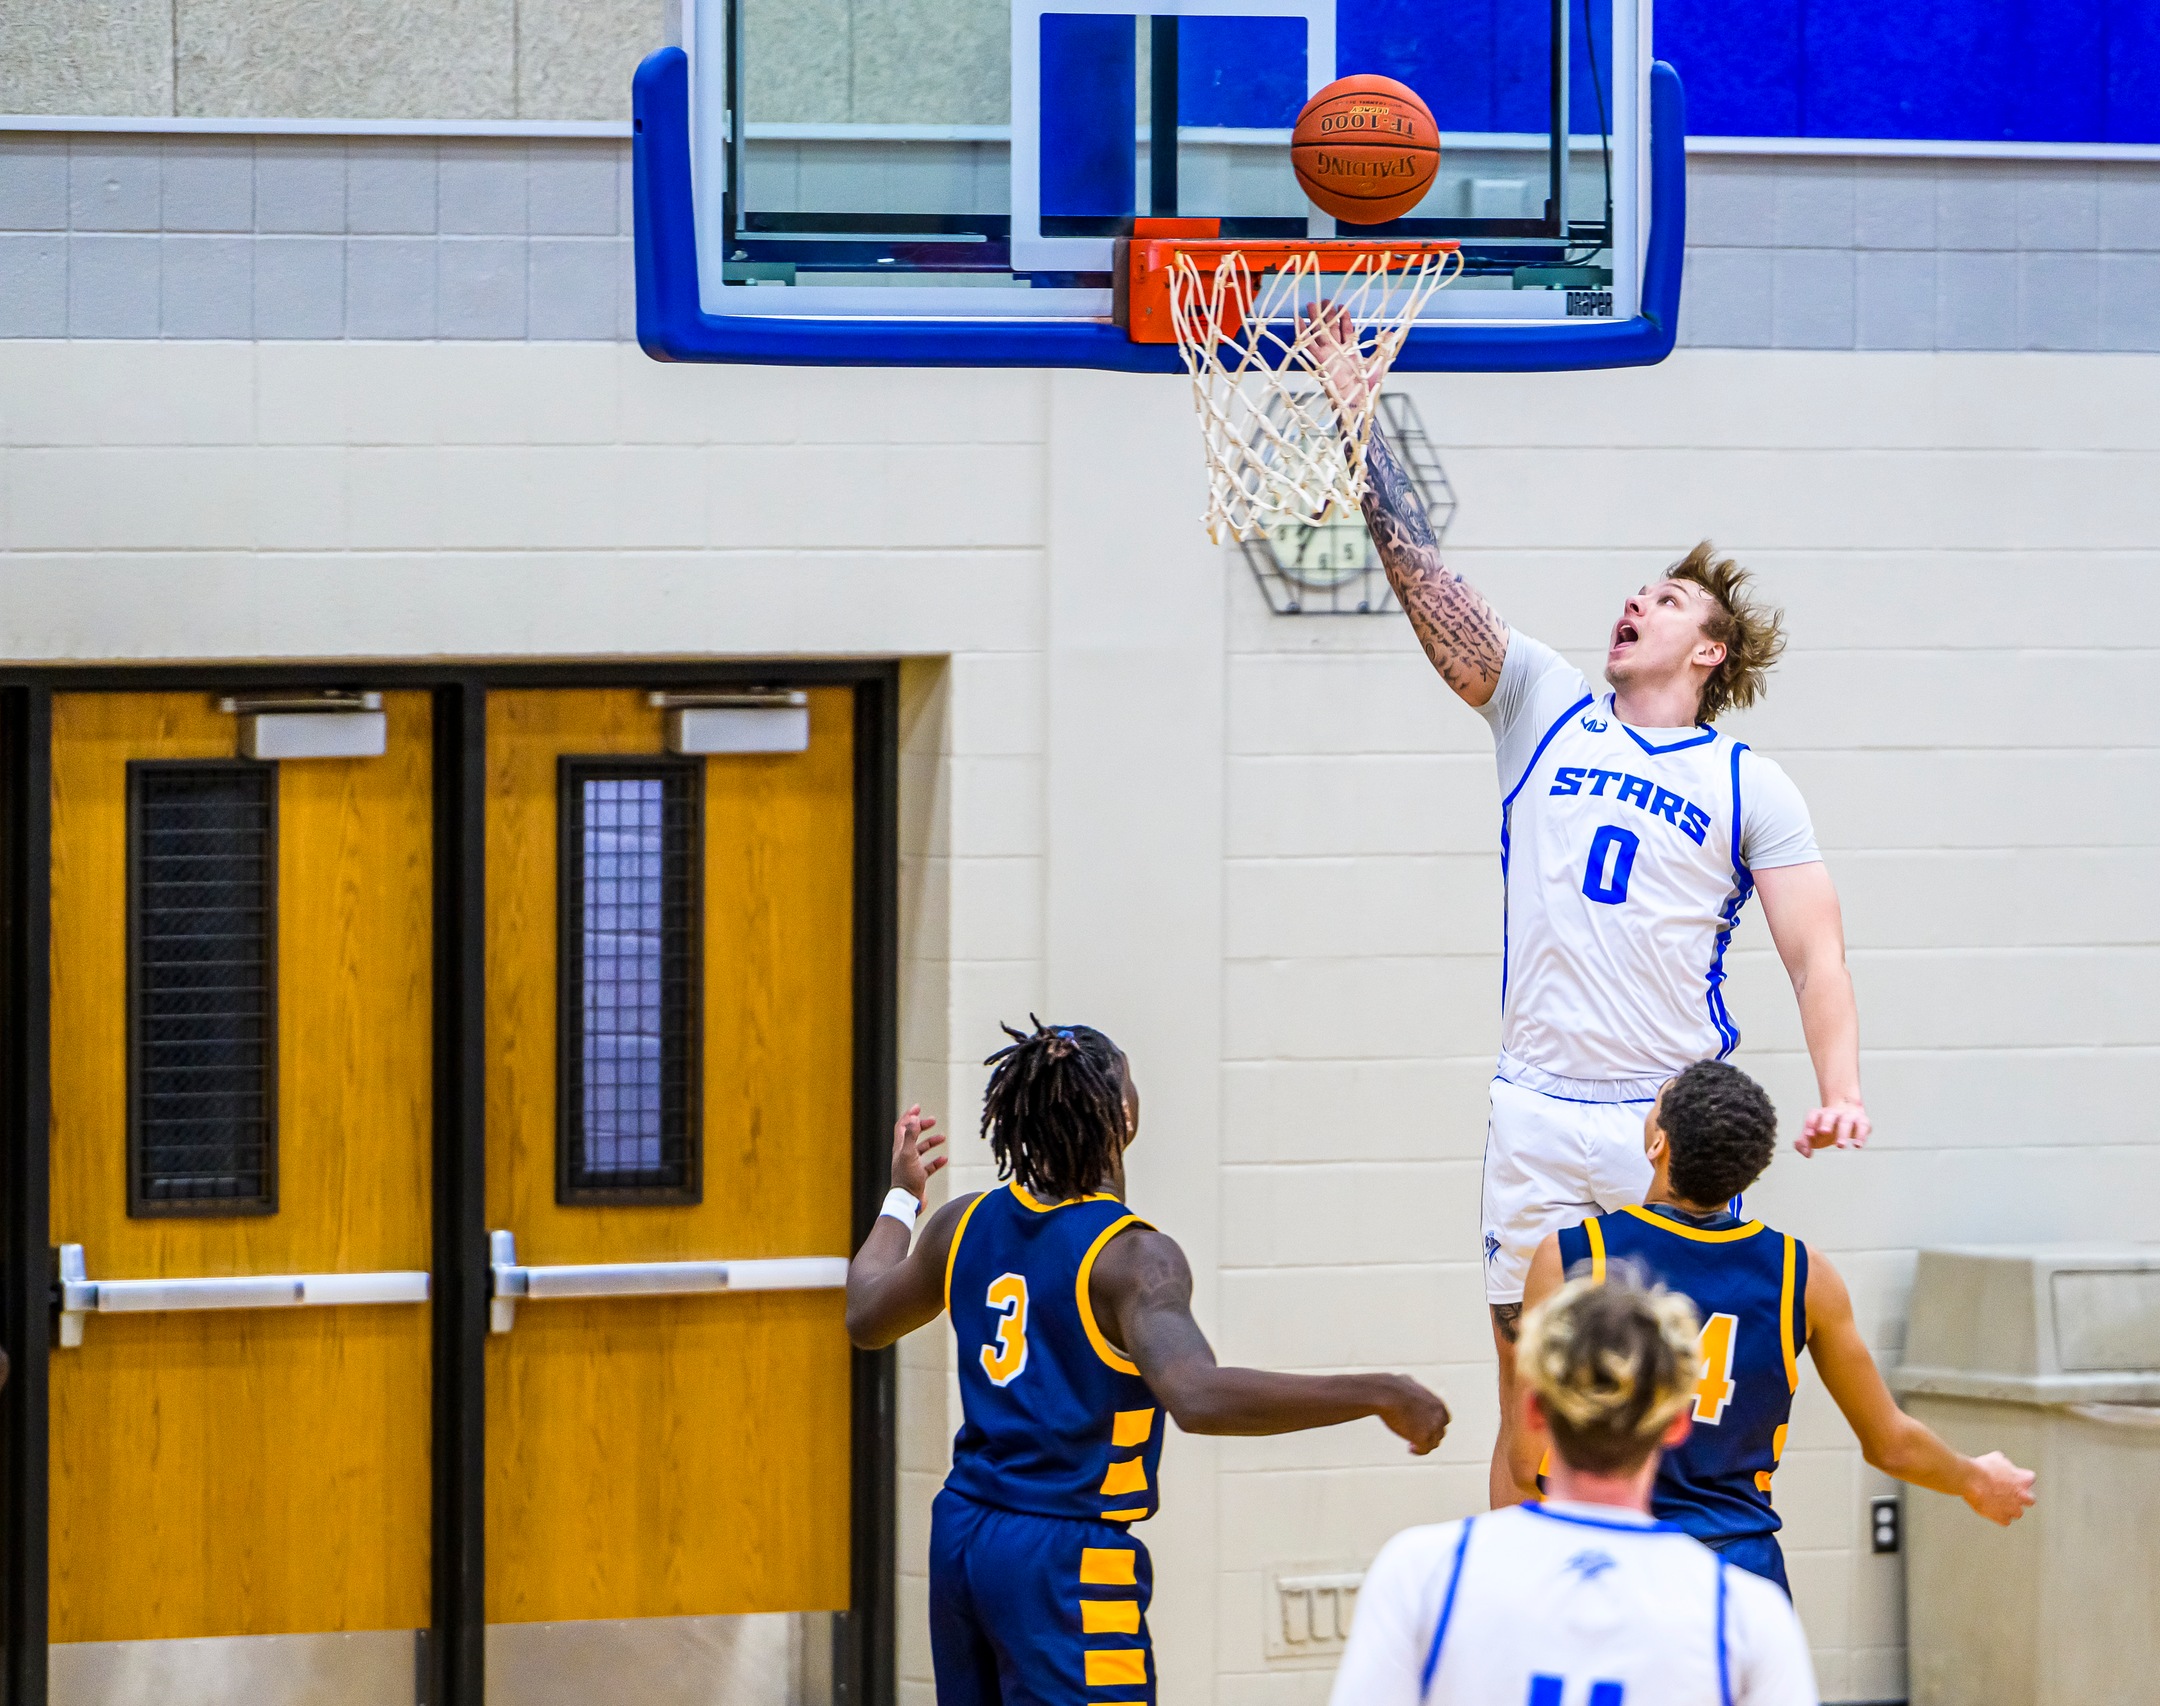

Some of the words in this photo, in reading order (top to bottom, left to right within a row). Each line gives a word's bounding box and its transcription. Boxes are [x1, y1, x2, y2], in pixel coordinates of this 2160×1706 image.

[1352, 106, 1388, 114] LEGACY
[1321, 114, 1415, 136] TF-1000
[1318, 151, 1416, 178] SPALDING
[1566, 292, 1613, 317] DRAPER
[1549, 767, 1712, 847] STARS
[1582, 824, 1640, 905] 0
[979, 1271, 1030, 1388] 3
